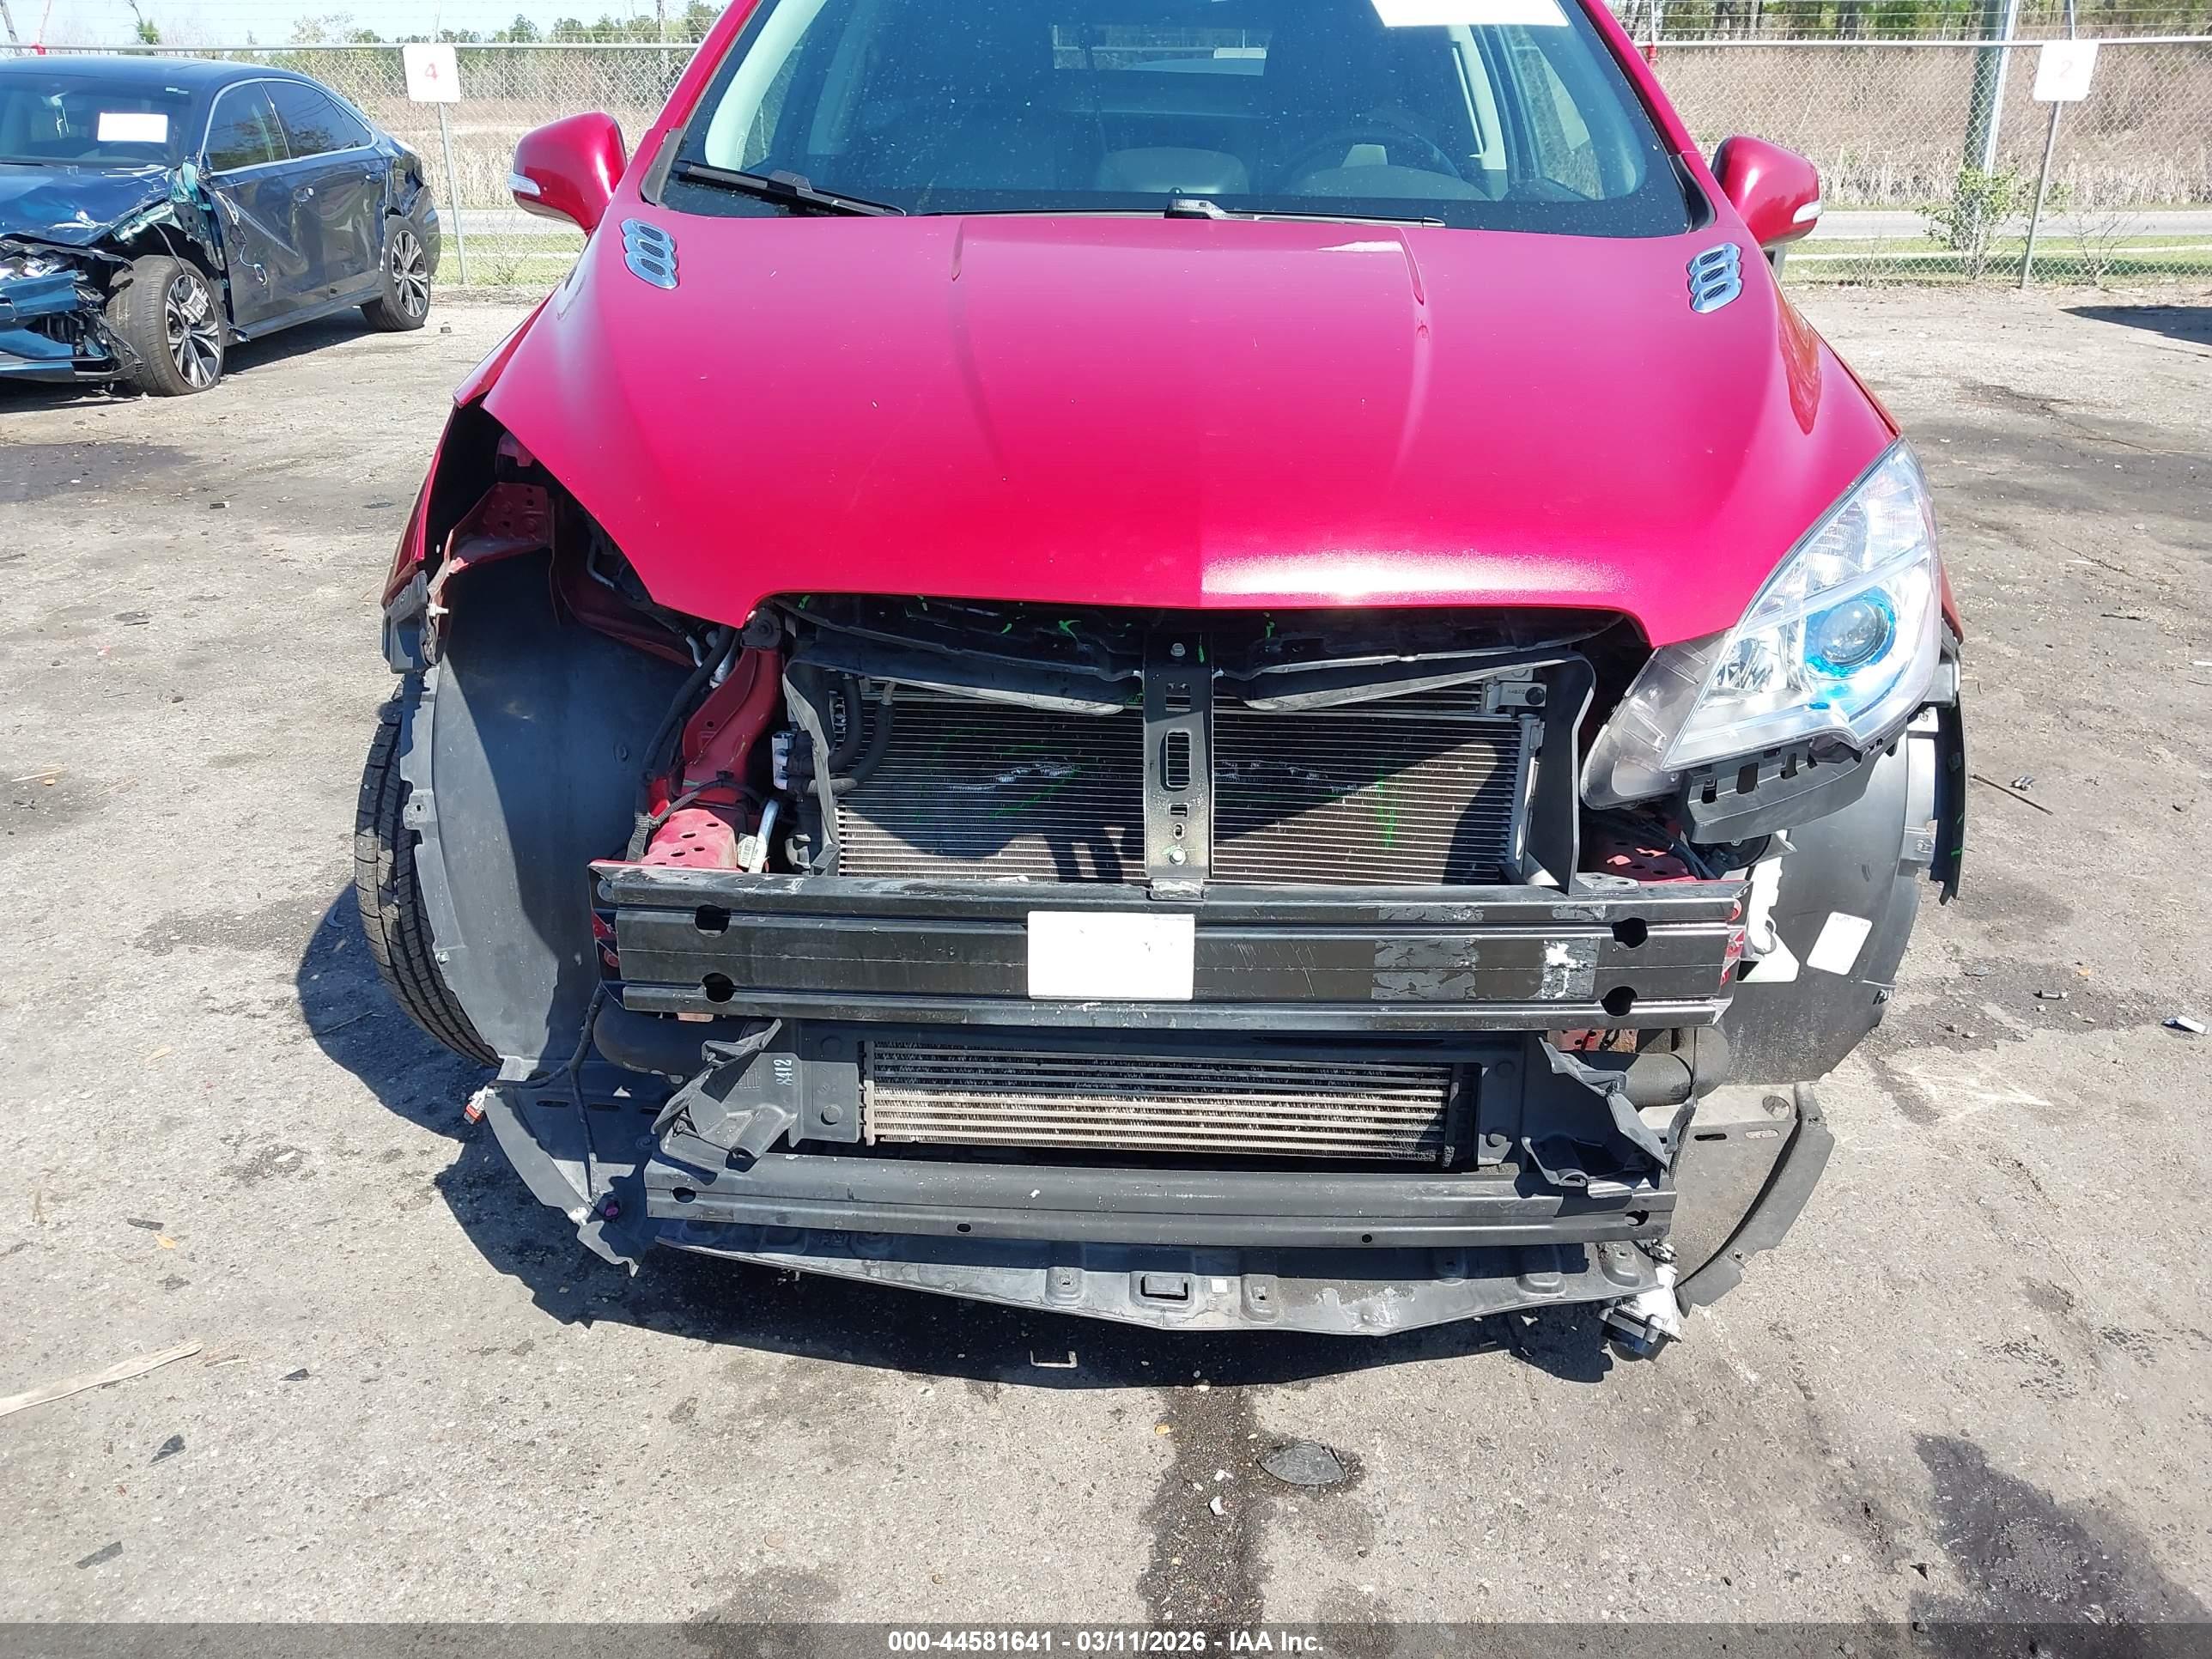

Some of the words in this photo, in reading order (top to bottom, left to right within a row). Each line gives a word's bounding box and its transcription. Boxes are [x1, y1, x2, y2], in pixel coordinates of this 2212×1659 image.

[424, 62, 440, 81] 4
[2058, 59, 2073, 78] 2
[774, 1059, 793, 1085] 8412
